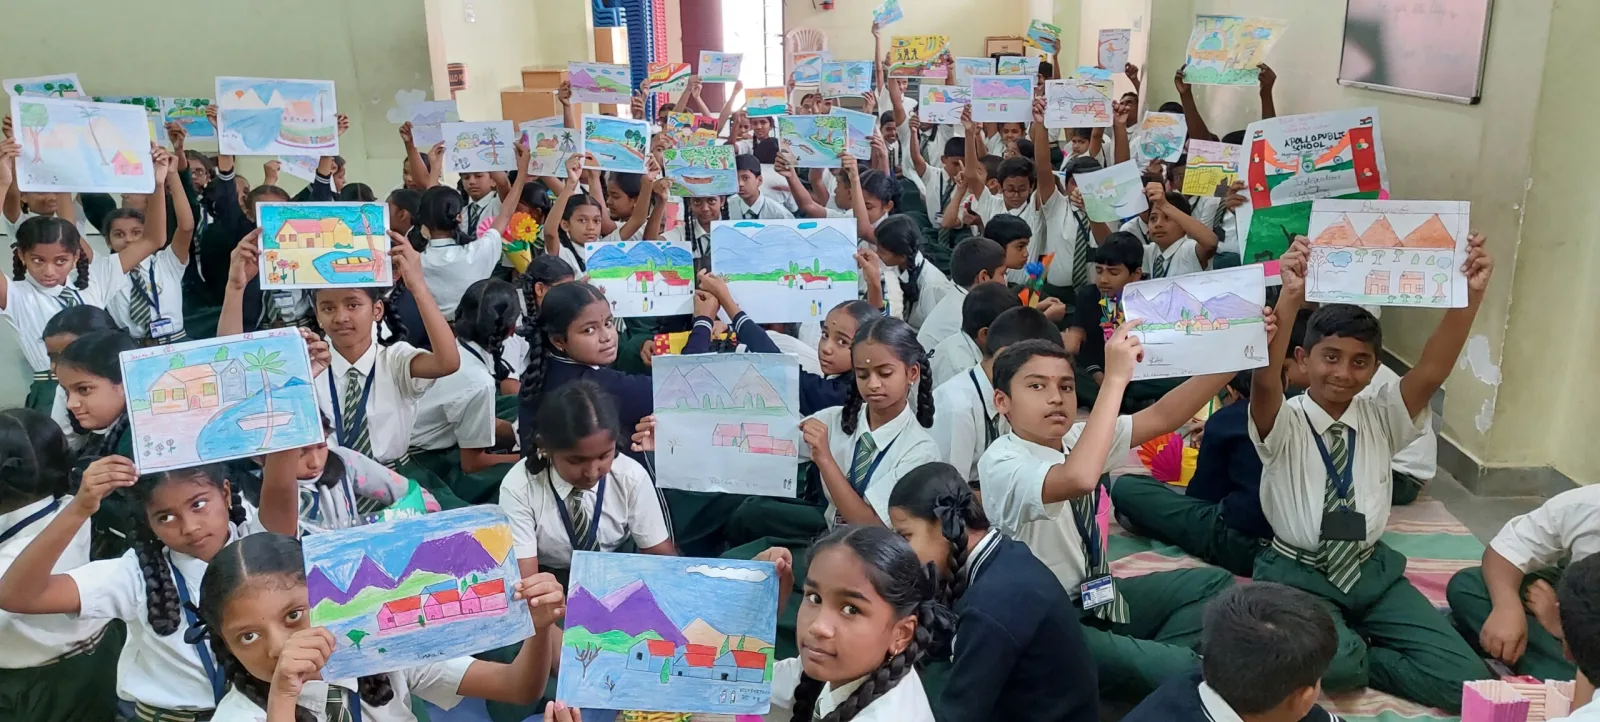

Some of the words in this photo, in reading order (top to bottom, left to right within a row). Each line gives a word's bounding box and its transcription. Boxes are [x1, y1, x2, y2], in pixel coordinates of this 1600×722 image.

[1284, 134, 1317, 147] APOLLO
[1317, 131, 1346, 141] PUBLIC
[1292, 141, 1326, 151] SCHOOL
